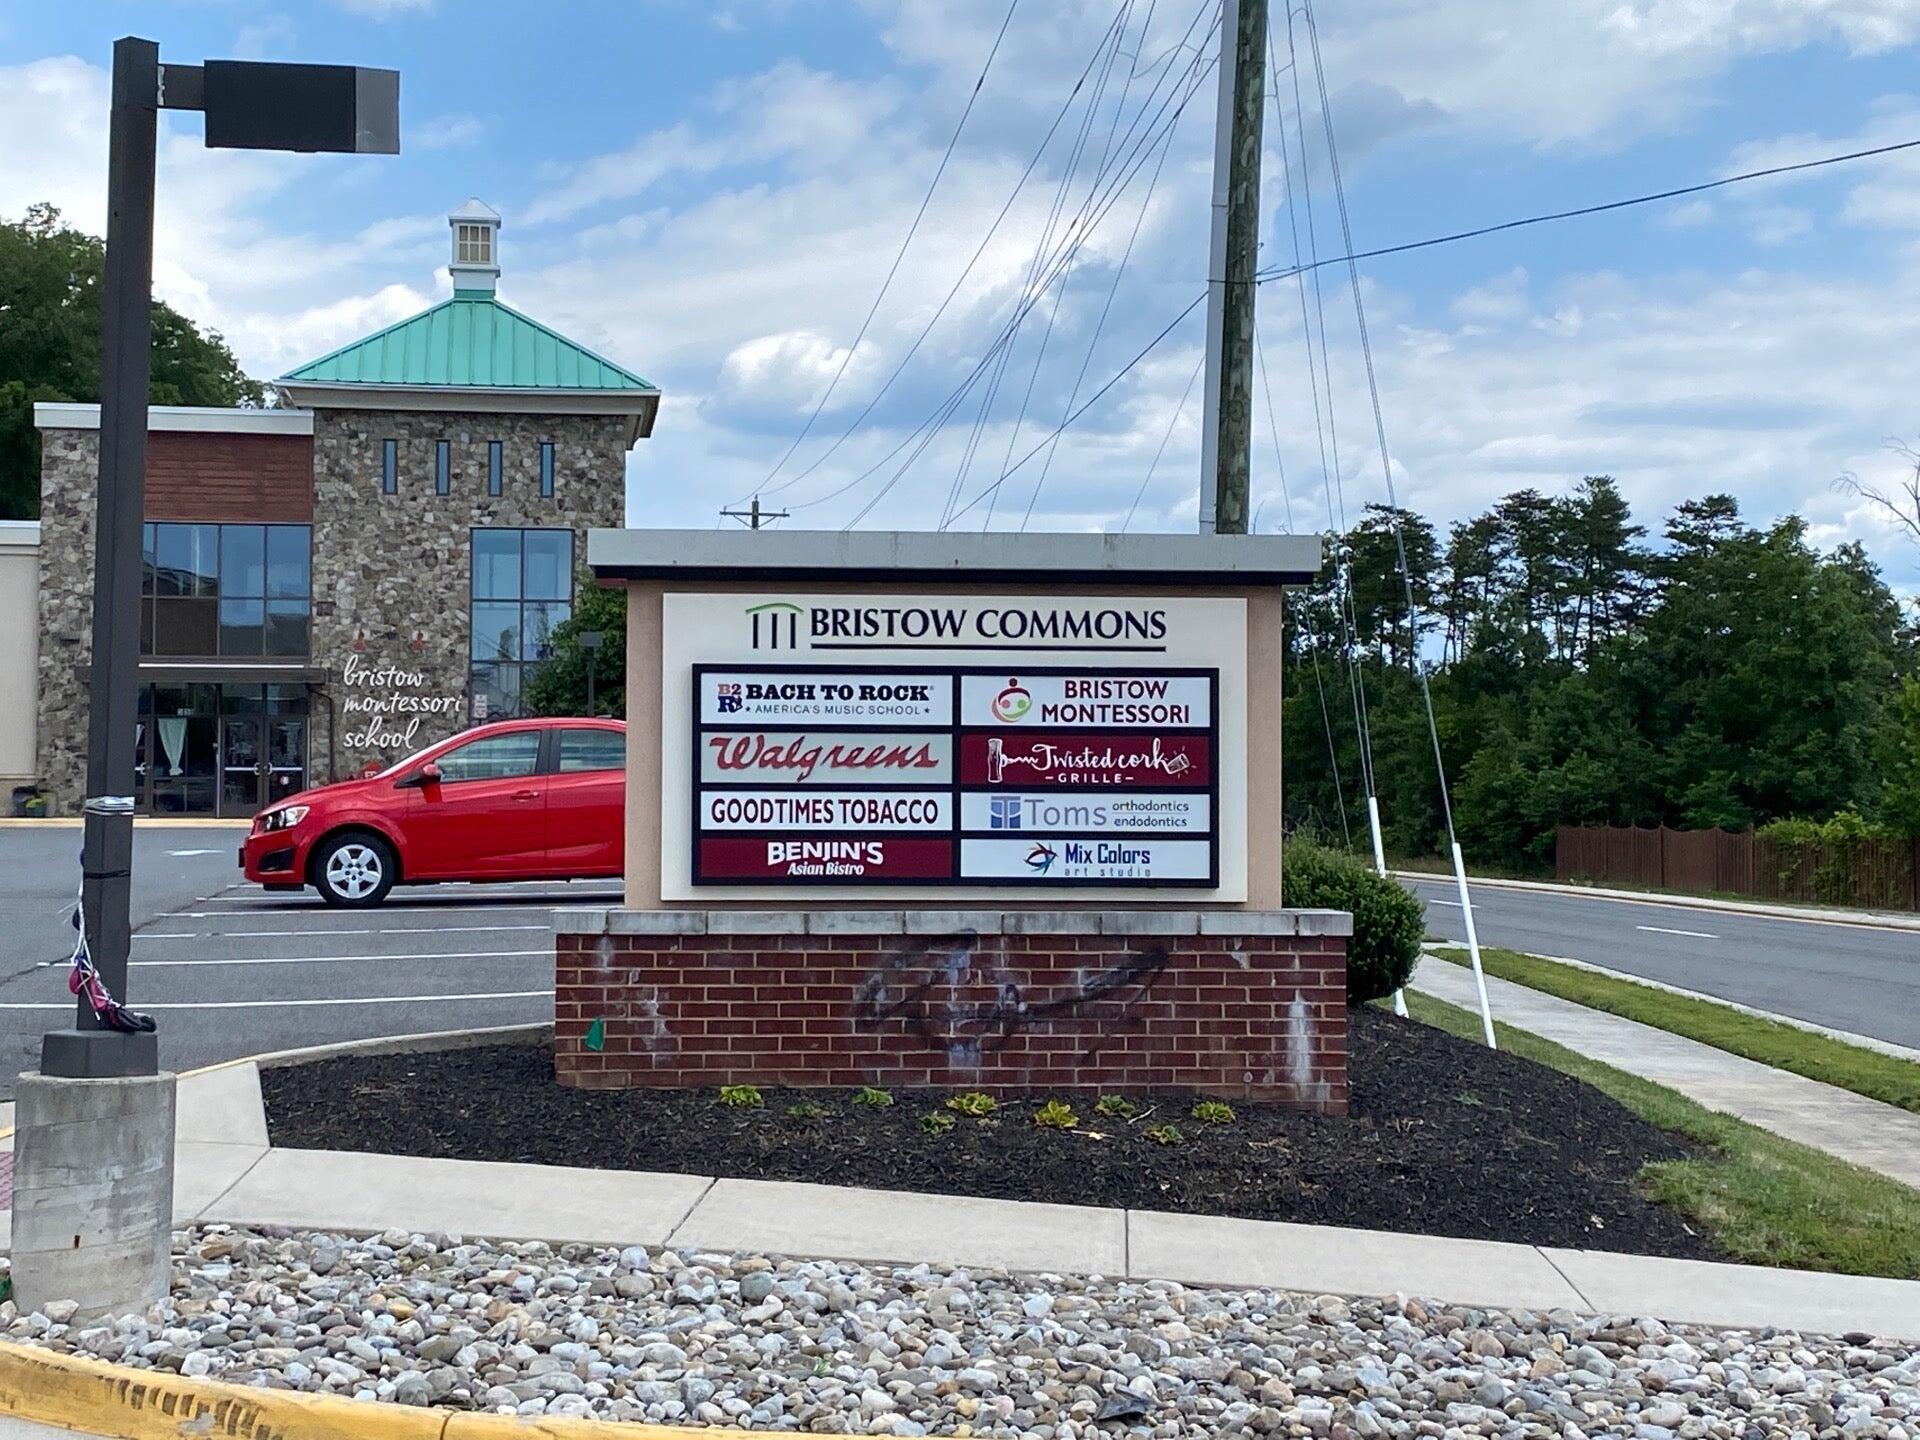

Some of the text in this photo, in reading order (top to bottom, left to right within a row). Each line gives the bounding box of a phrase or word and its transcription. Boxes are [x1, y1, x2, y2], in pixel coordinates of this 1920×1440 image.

[810, 608, 1167, 639] BRISTOW COMMONS
[343, 654, 425, 687] bristow
[746, 684, 930, 701] BACH TO ROCK
[1065, 681, 1169, 699] BRISTOW
[343, 691, 463, 713] montessori
[755, 704, 921, 715] AMERICA'S MUSIC SCHOOL
[1041, 704, 1189, 723] MONTESSORI
[343, 716, 420, 749] school
[709, 734, 940, 783] Walgreens
[711, 798, 939, 824] GOODTIMES TOBACCO
[1024, 799, 1107, 826] Toms
[1112, 800, 1189, 812] orthodontics
[1114, 817, 1188, 828] endodontics
[767, 841, 884, 866] BENJIN'S
[1065, 843, 1151, 865] Mix Colors
[787, 861, 865, 876] Asian Bistro
[1064, 866, 1151, 877] art studio
